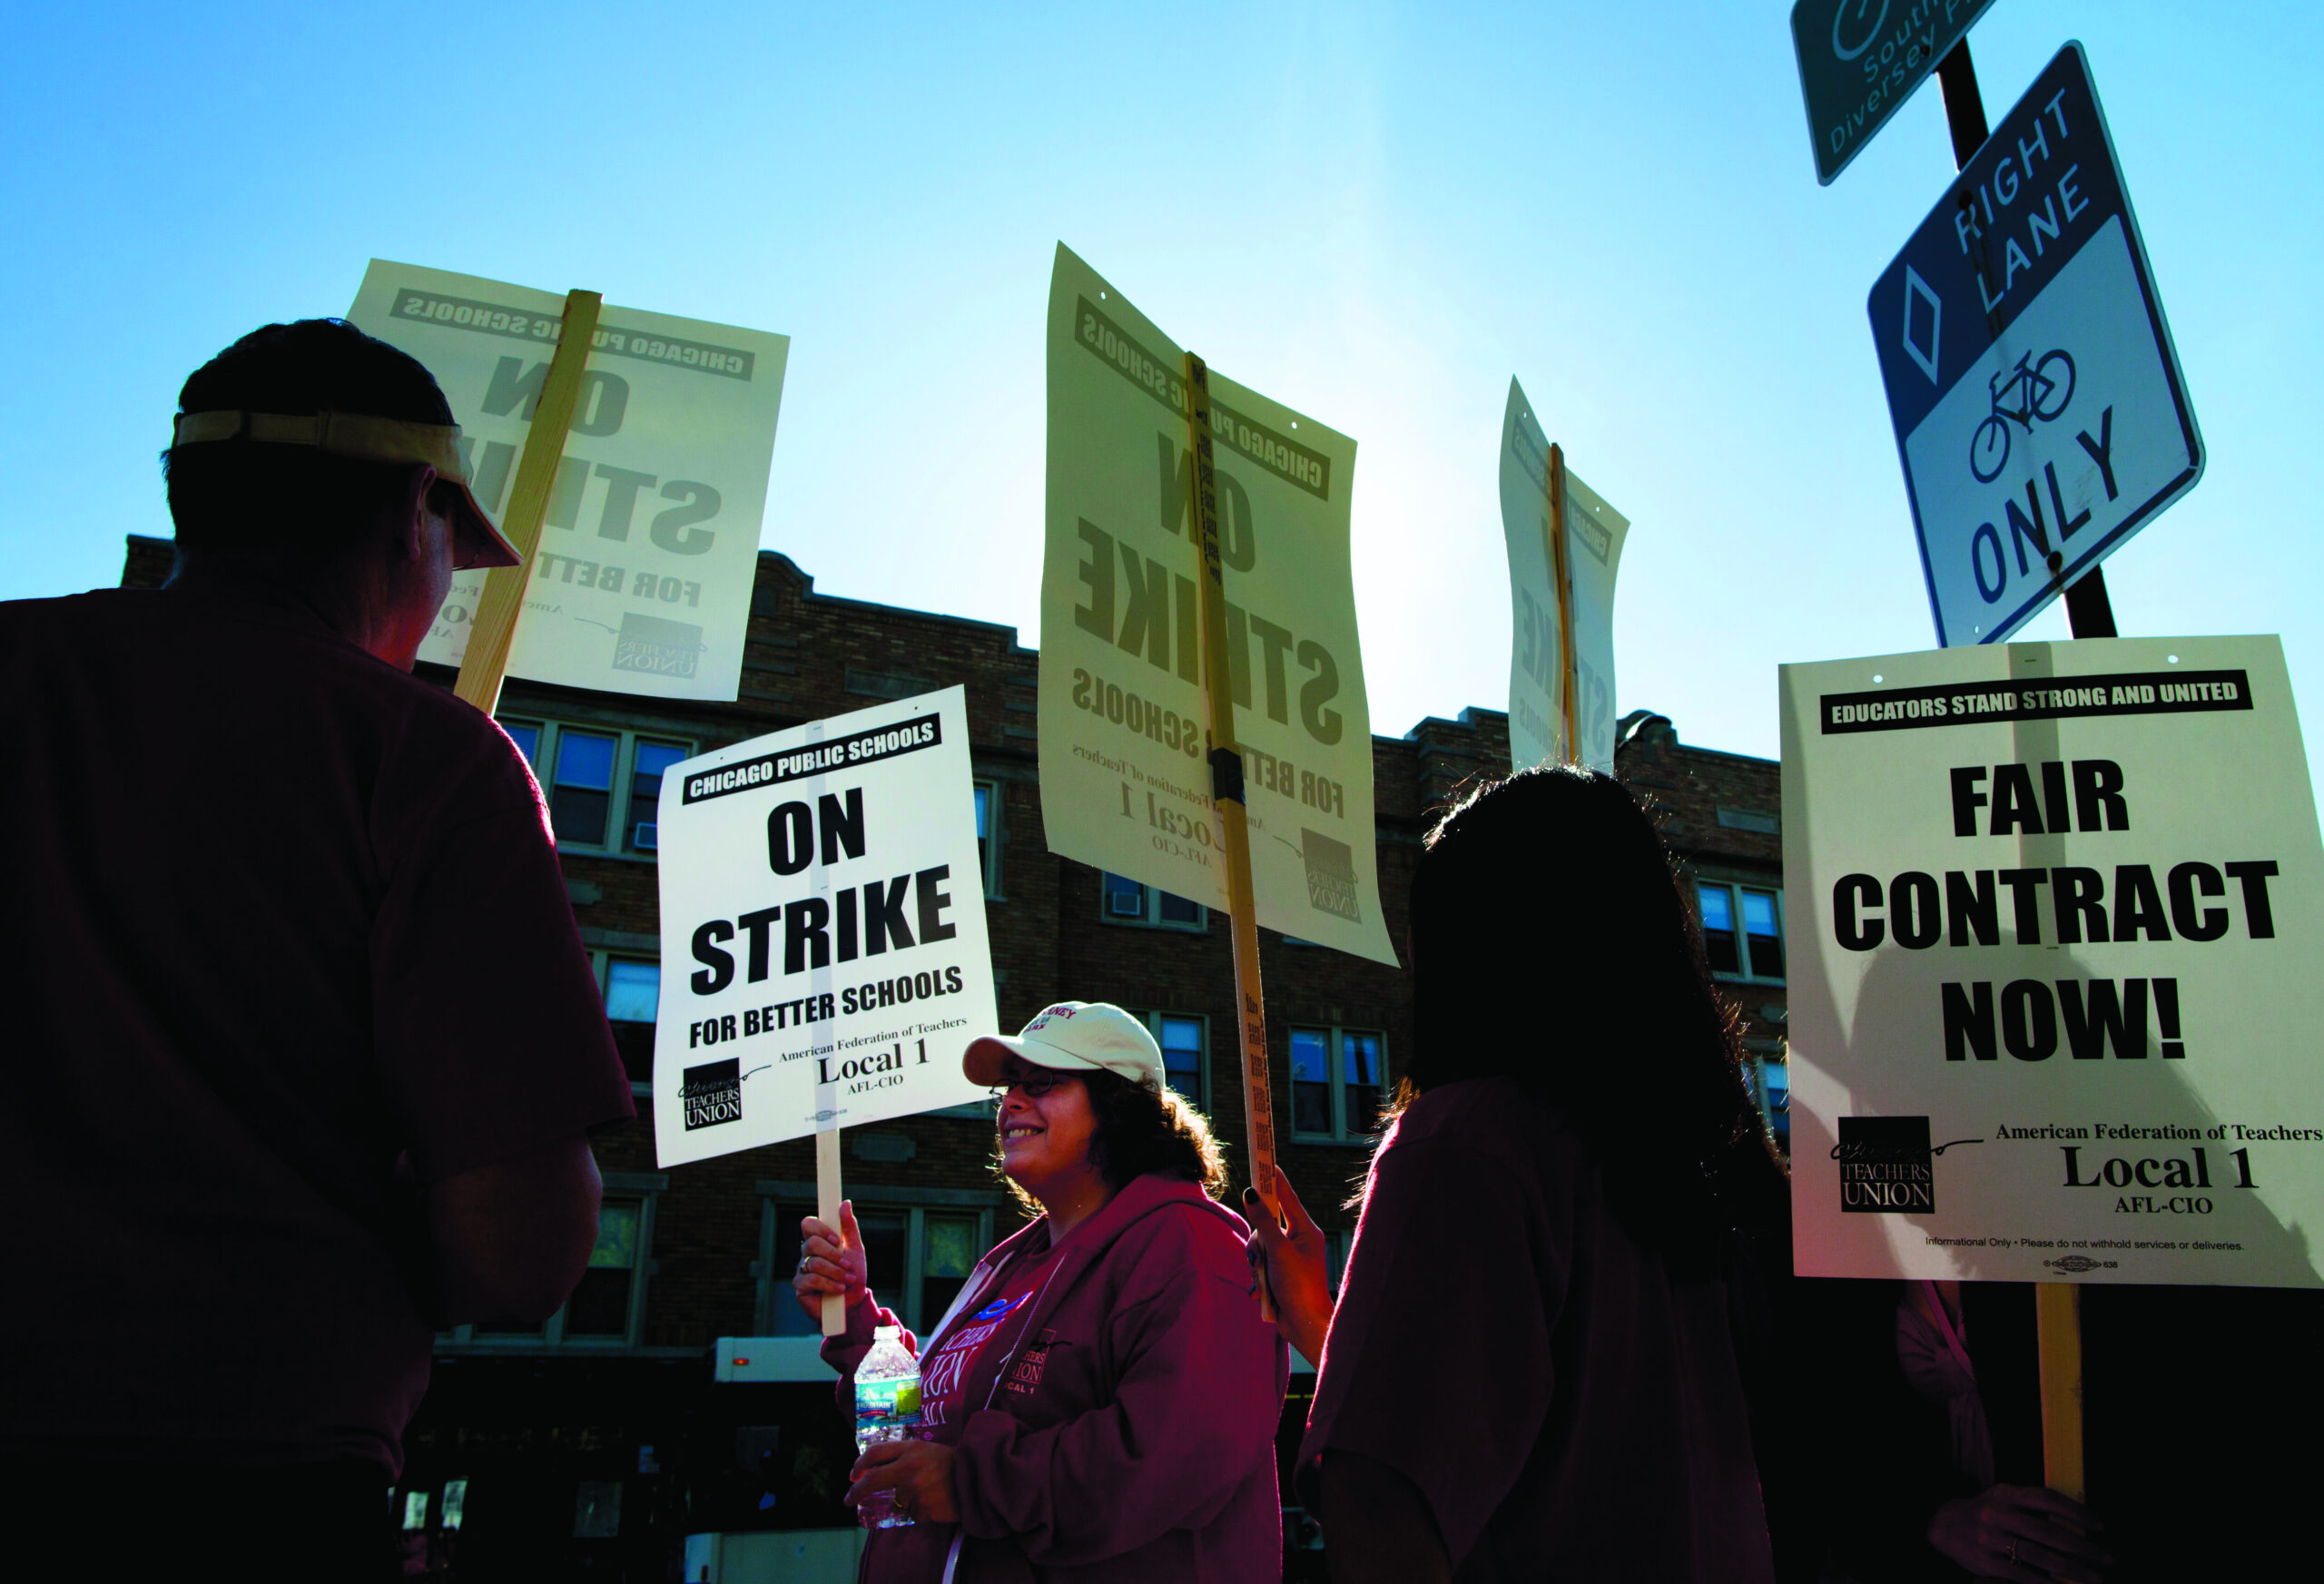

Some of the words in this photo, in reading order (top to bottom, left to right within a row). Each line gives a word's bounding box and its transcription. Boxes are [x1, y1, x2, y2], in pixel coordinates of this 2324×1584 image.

[1830, 24, 1935, 154] Diversey
[1954, 88, 2067, 254] RIGHT
[1978, 163, 2089, 314] LANE
[1972, 405, 2119, 604] ONLY
[1832, 696, 1948, 724] EDUCATORS
[1952, 692, 2017, 714] STAND
[2022, 688, 2107, 710] STRONG
[2112, 685, 2155, 704] AND
[2160, 682, 2238, 703] UNITED
[690, 762, 773, 798] CHICAGO
[777, 745, 844, 778] PUBLIC
[848, 723, 934, 761] SCHOOLS
[1950, 760, 2130, 838] FAIR
[767, 787, 866, 876] ON
[1832, 861, 2280, 952] CONTRACT
[690, 864, 957, 997] STRIKE
[690, 1014, 737, 1048] FOR
[743, 993, 835, 1037] BETTER
[842, 965, 963, 1016] SCHOOLS
[1941, 977, 2185, 1062] NOW!
[779, 1044, 834, 1063] American
[837, 1030, 899, 1050] Federation
[901, 1025, 913, 1038] of
[915, 1017, 967, 1035] Teachers
[817, 1043, 903, 1085] Local
[914, 1038, 931, 1065] 1
[685, 1087, 739, 1110] TEACHERS
[848, 1074, 903, 1095] AFL-CIO
[685, 1100, 740, 1126] UNION
[1996, 1124, 2089, 1140] American
[2093, 1124, 2202, 1140] Federation
[2207, 1125, 2227, 1140] of
[2231, 1125, 2323, 1141] Teachers
[1842, 1163, 1930, 1180] TEACHERS
[2059, 1146, 2213, 1188] Local
[2229, 1146, 2260, 1188] 1
[1843, 1182, 1931, 1206] UNION
[2114, 1196, 2213, 1215] AFL-CIO
[1925, 1236, 1986, 1247] Informational
[1989, 1237, 2012, 1249] Only
[2021, 1238, 2054, 1248] Please
[2057, 1239, 2069, 1248] do
[2072, 1240, 2087, 1248] not
[2090, 1239, 2132, 1249] withhold
[2134, 1242, 2176, 1250] services
[2192, 1241, 2245, 1251] deliveries.
[922, 1345, 979, 1398] ION
[1005, 1382, 1027, 1393] CAL
[1013, 1363, 1042, 1382] ION
